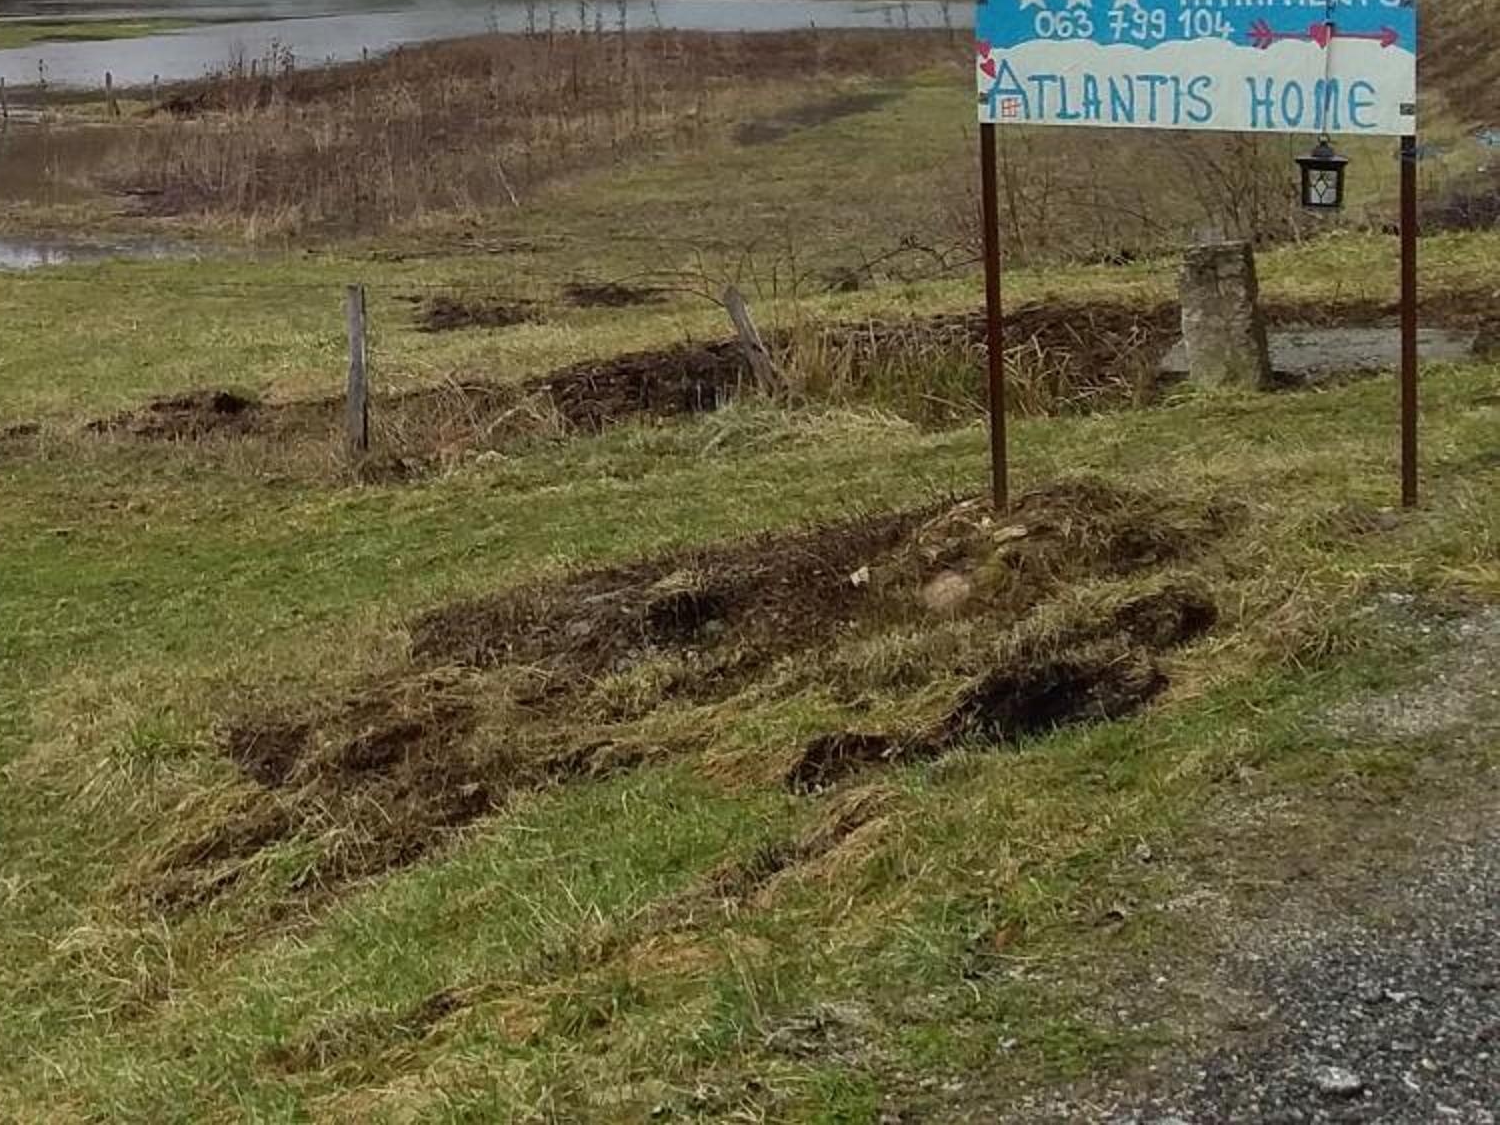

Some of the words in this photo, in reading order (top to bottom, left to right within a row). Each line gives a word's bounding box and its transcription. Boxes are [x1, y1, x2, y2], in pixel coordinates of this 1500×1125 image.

[1035, 9, 1094, 38] 063
[1107, 8, 1166, 40] 799
[1178, 8, 1235, 40] 104
[988, 58, 1213, 125] ATLANTIS
[1245, 76, 1378, 130] HOME
